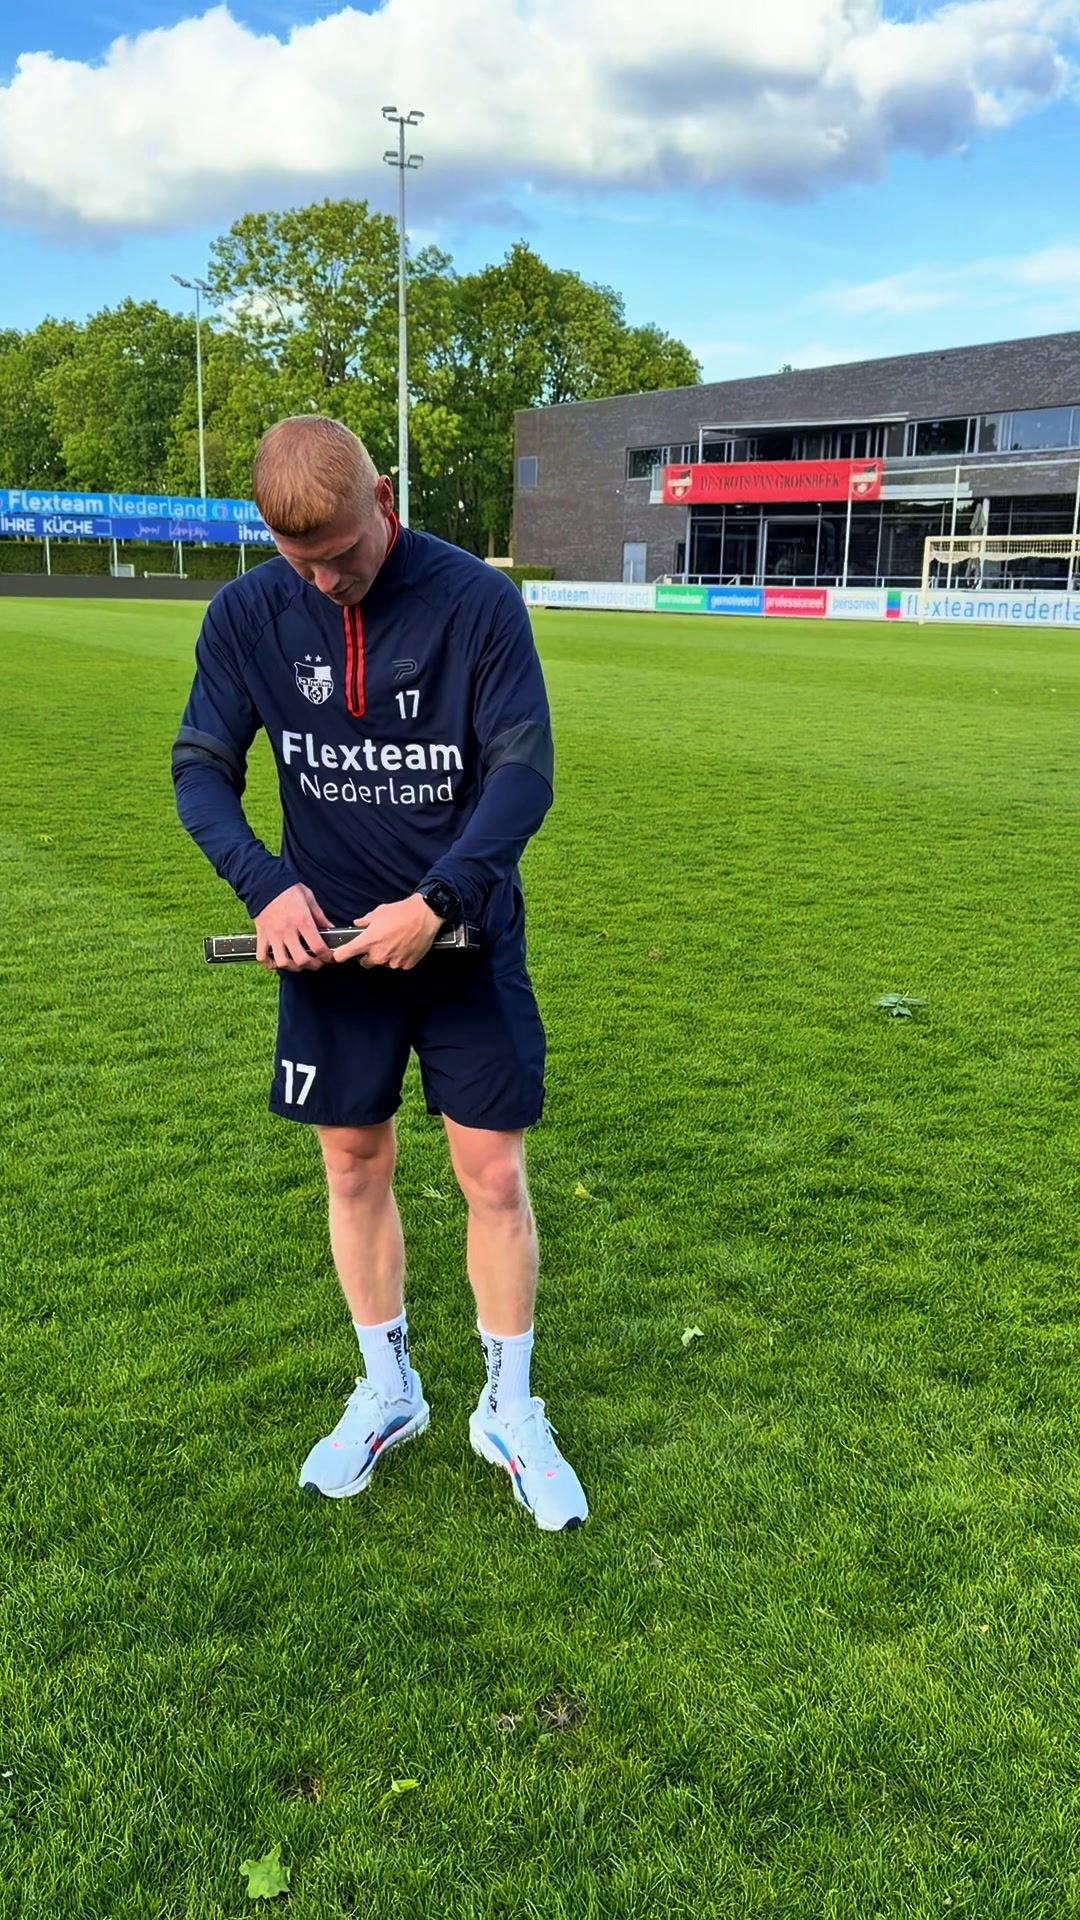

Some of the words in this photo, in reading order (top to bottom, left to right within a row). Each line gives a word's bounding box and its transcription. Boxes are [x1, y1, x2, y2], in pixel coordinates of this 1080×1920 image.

[752, 473, 774, 489] VAN
[9, 489, 103, 513] Flexteam
[109, 494, 206, 517] Nederland
[43, 516, 94, 534] KÜCHE
[541, 586, 589, 602] Flexteam
[766, 594, 824, 610] professioneel
[395, 689, 420, 720] 17
[282, 730, 464, 771] Flexteam
[300, 772, 454, 805] Nederland
[281, 1059, 317, 1106] 17
